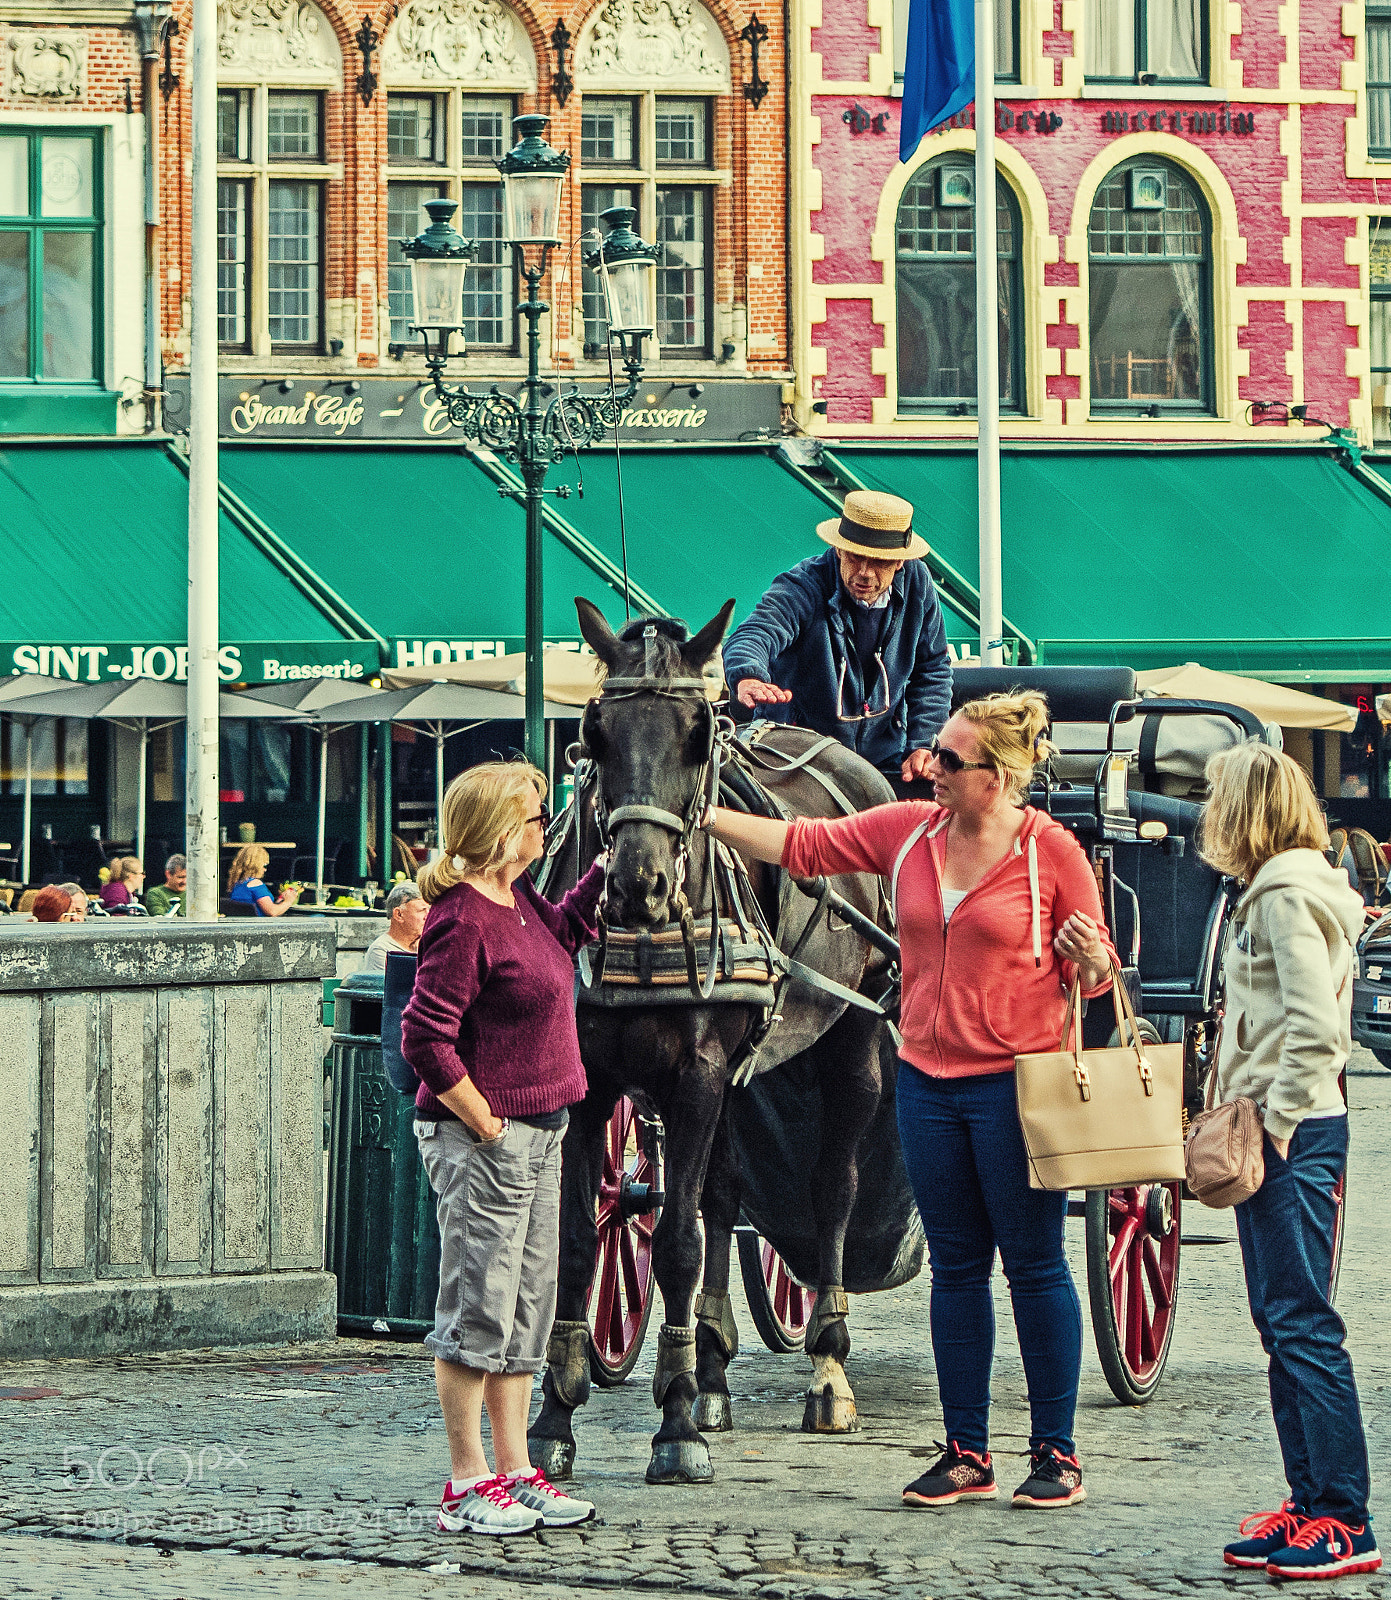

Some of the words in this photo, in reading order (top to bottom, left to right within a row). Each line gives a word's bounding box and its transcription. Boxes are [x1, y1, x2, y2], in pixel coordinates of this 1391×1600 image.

[1105, 102, 1255, 134] meermin
[231, 394, 312, 434] Grand
[12, 645, 243, 681] SINT-JOS
[263, 658, 364, 680] Brasserie
